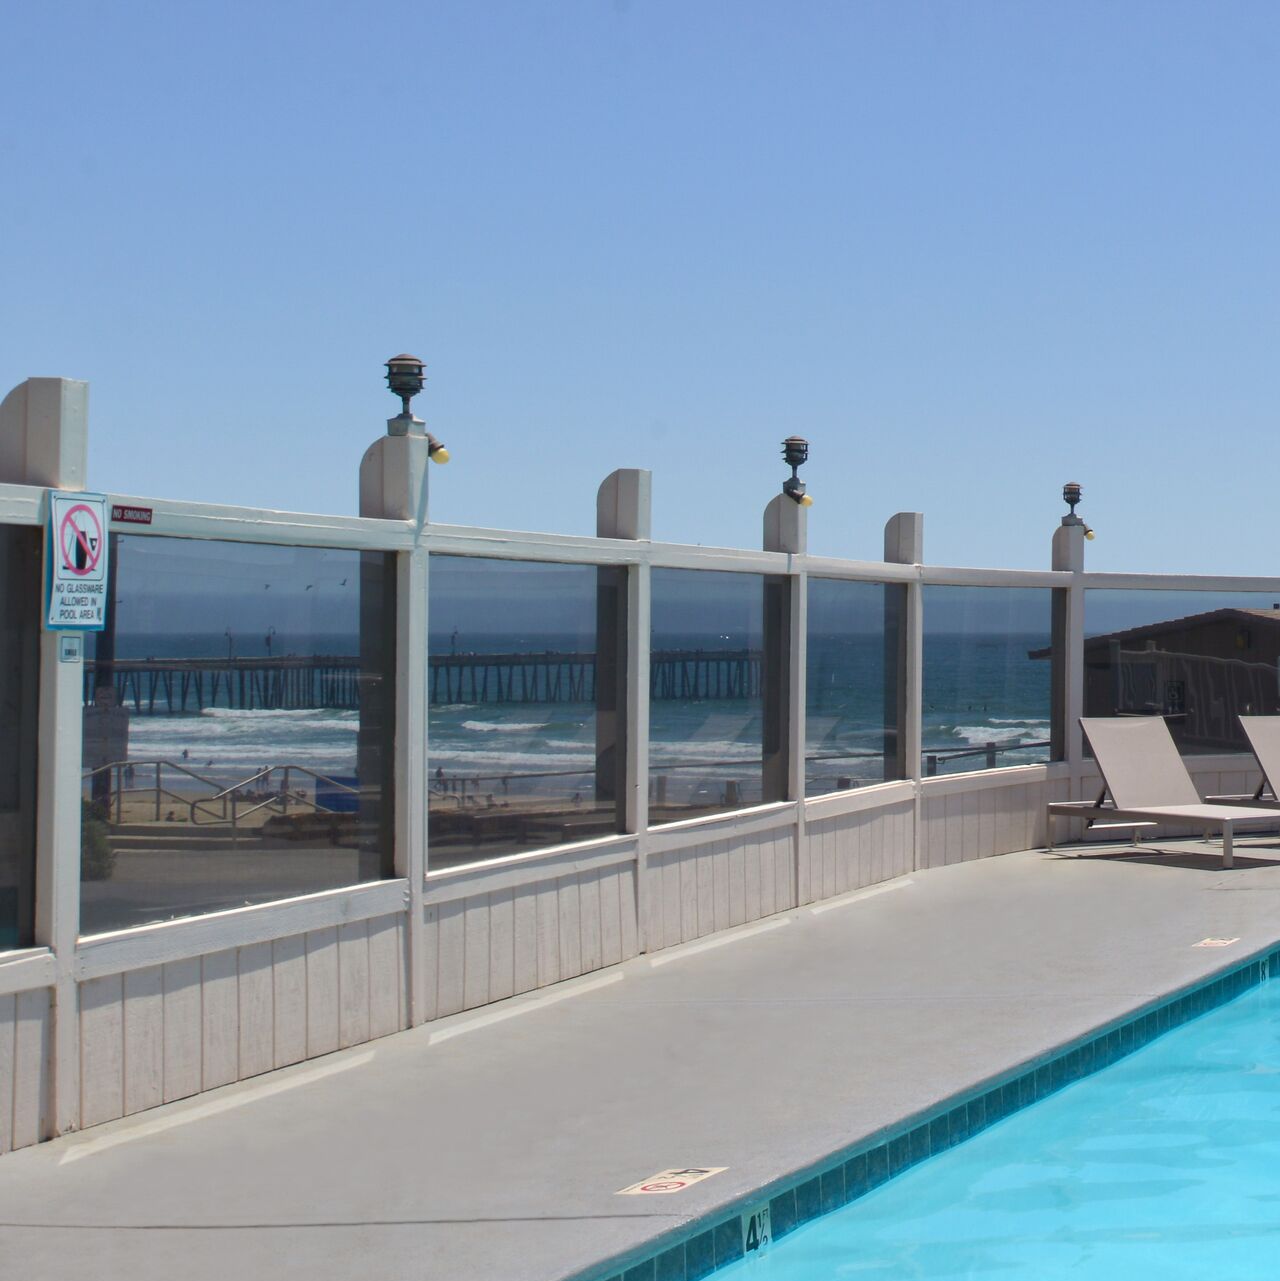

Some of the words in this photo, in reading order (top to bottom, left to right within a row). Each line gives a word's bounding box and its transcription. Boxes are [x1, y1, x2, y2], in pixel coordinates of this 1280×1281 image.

[112, 508, 122, 519] NO
[124, 509, 151, 522] SMOKING
[55, 584, 64, 593] NO
[67, 583, 104, 594] GLASSWARE
[60, 597, 89, 606] ALLOWED
[90, 597, 97, 606] IN
[59, 609, 77, 619] POOL
[79, 610, 94, 619] AREA
[746, 1215, 759, 1252] 4
